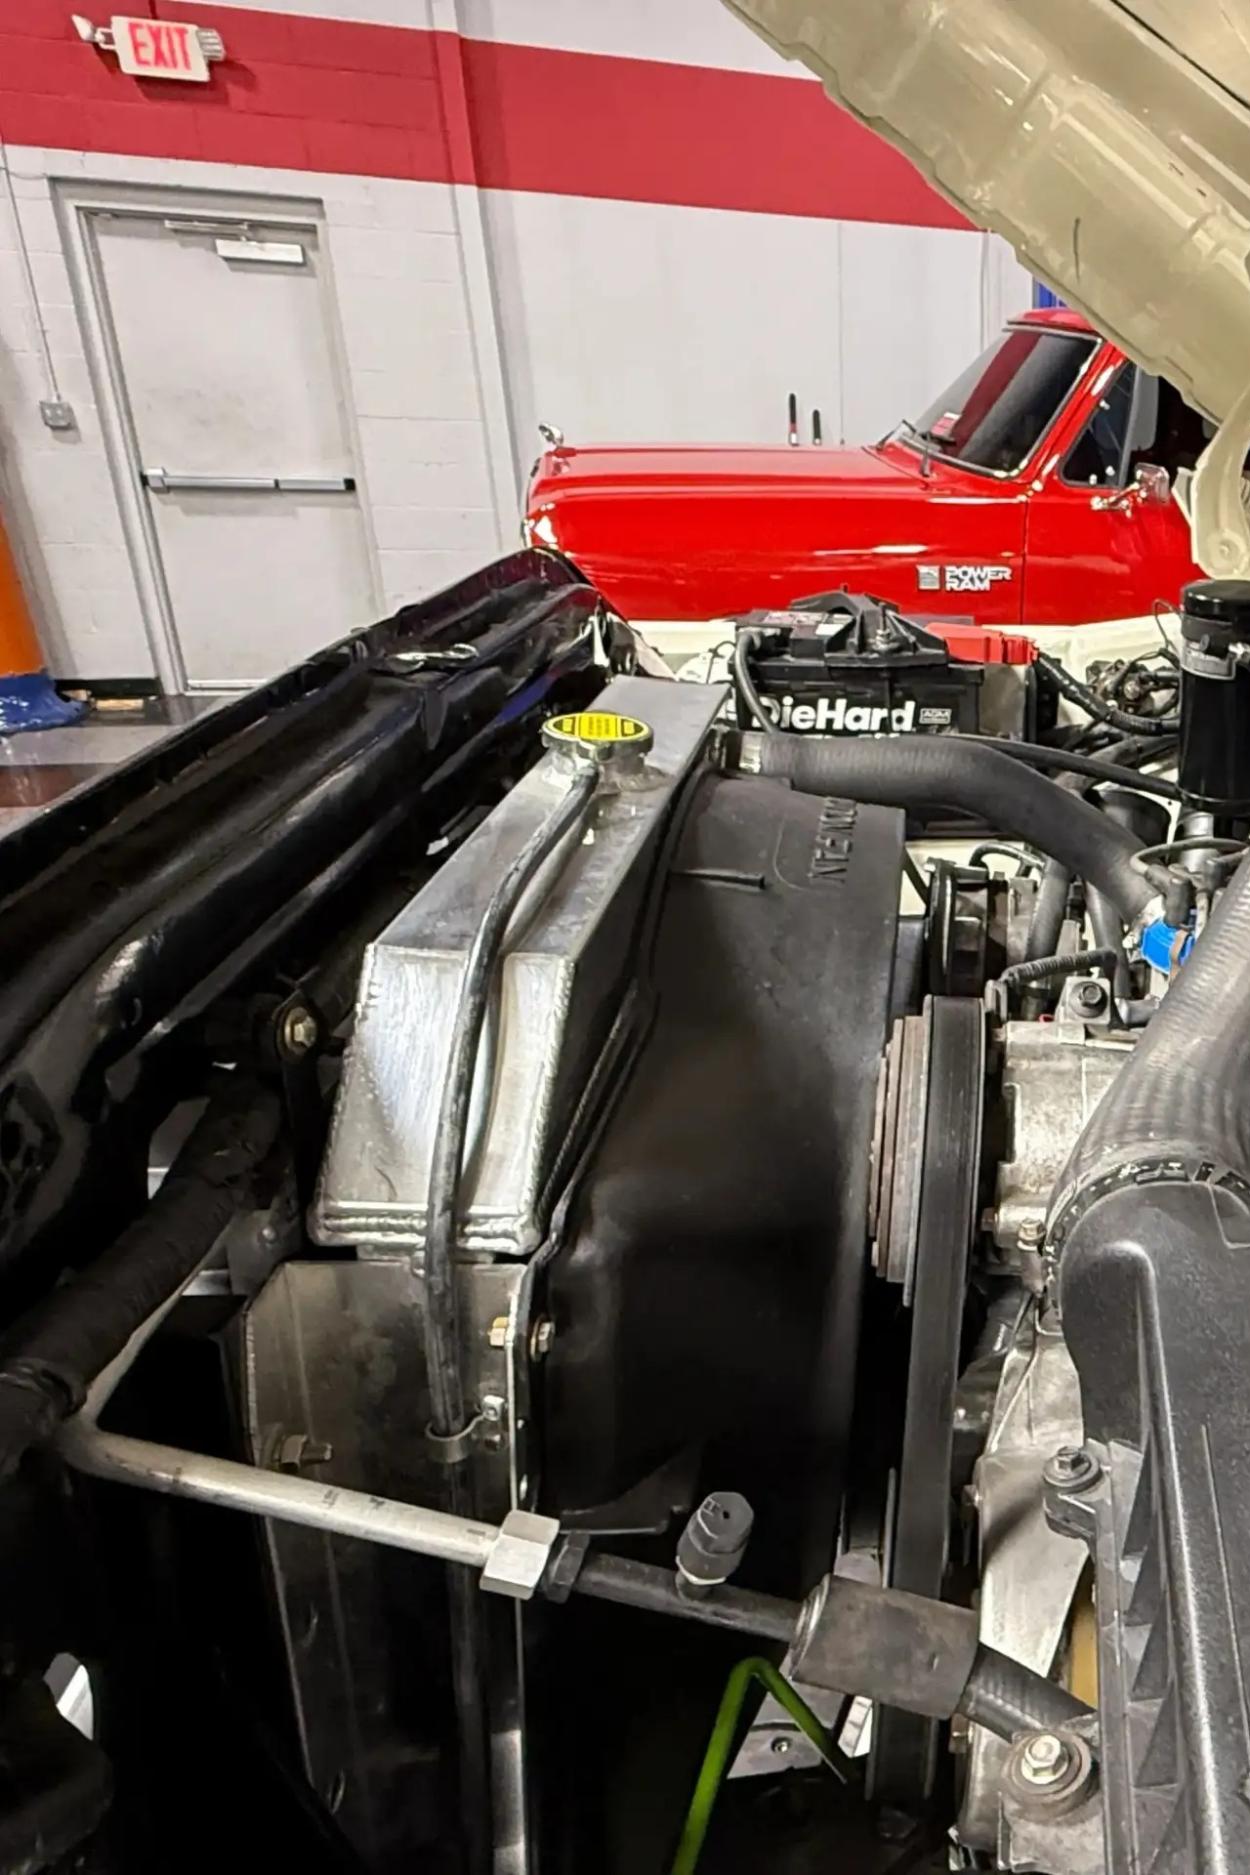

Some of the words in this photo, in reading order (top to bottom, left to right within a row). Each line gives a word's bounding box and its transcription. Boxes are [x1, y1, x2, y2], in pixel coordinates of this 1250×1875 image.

[128, 22, 191, 71] EXIT
[945, 565, 1012, 580] POWER
[945, 579, 991, 591] RAM
[752, 696, 916, 732] DieHard
